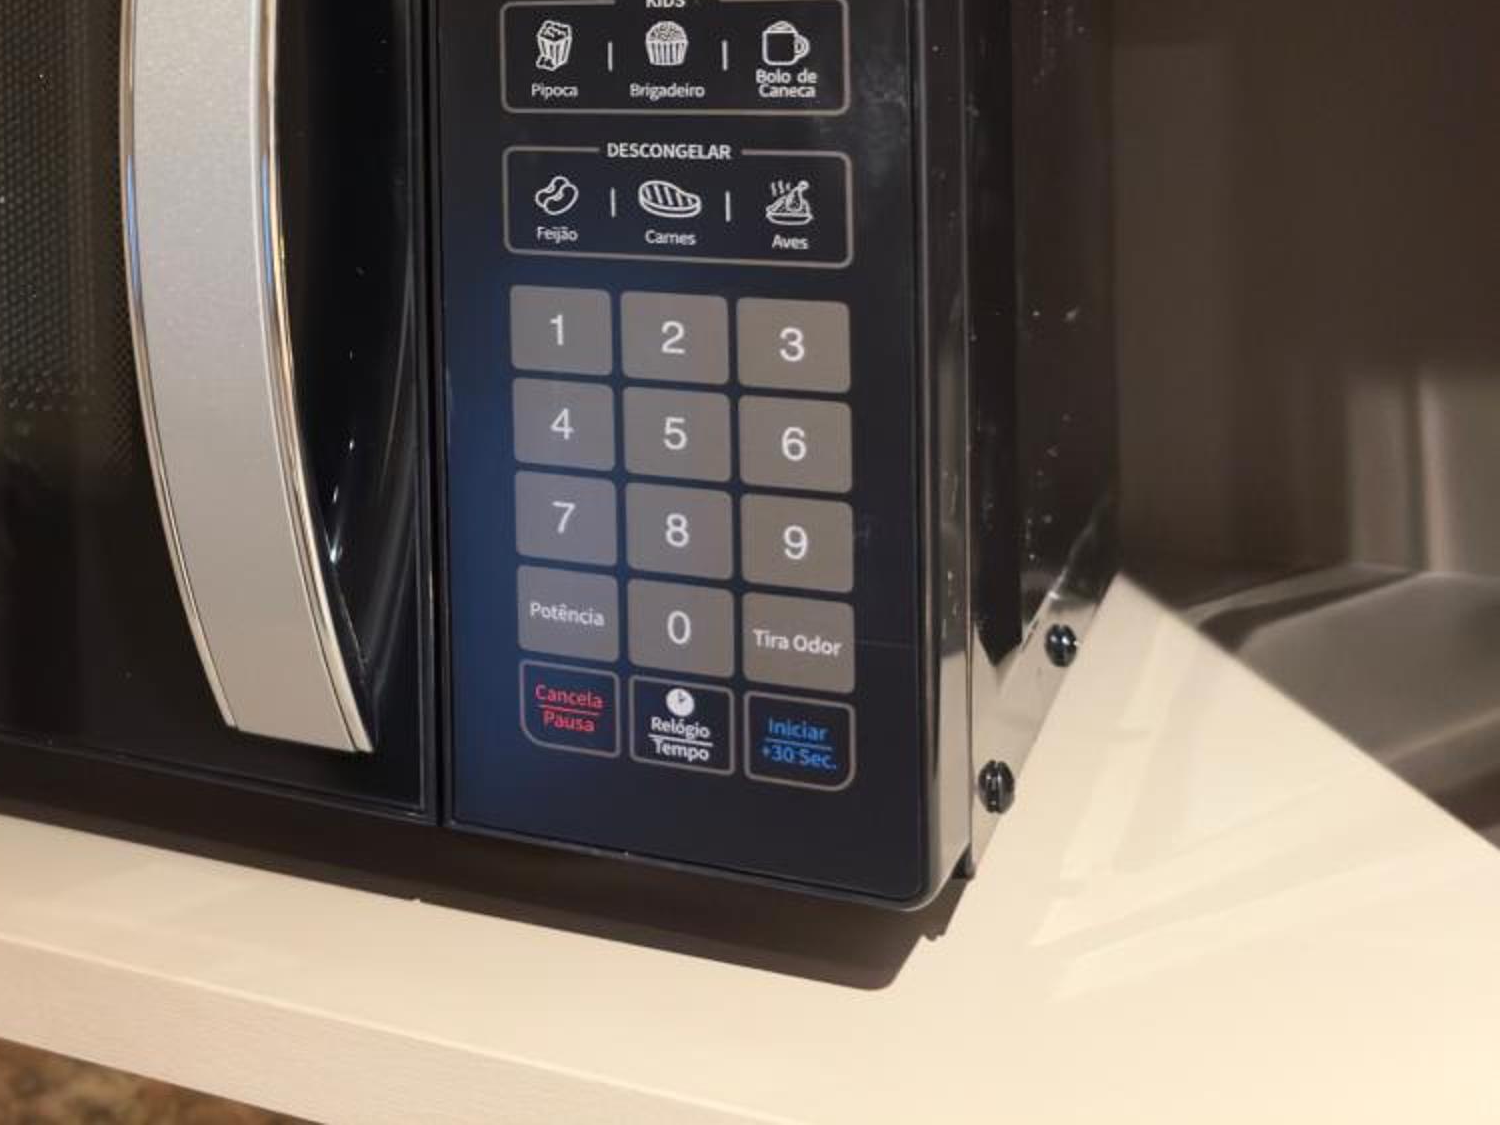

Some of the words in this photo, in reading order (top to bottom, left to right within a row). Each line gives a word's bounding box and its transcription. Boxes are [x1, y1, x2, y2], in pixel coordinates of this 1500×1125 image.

[755, 68, 791, 84] Bolo
[796, 68, 818, 84] de
[531, 82, 579, 100] Pipoca
[629, 82, 706, 102] Brigadeiro
[758, 83, 816, 99] Caneca
[606, 142, 732, 160] DESCONGELAR
[536, 226, 579, 244] Feijão
[644, 229, 697, 246] Carnes
[771, 234, 809, 251] Aves
[549, 314, 565, 346] 1
[661, 320, 686, 355] 2
[779, 327, 806, 362] 3
[550, 407, 575, 441] 4
[663, 416, 688, 450] 5
[781, 426, 807, 462] 6
[551, 500, 576, 534] 7
[665, 513, 690, 548] 8
[783, 525, 809, 560] 9
[529, 601, 606, 627] Potência
[667, 610, 692, 645] 0
[752, 628, 790, 652] Tira
[792, 634, 843, 658] Odor
[535, 684, 603, 709] Cancela
[543, 709, 596, 732] Pausa
[650, 715, 712, 741] Relógio
[768, 717, 829, 741] Iniciar
[652, 738, 711, 763] Tempo
[761, 745, 794, 764] +30
[799, 747, 838, 771] Sec.
